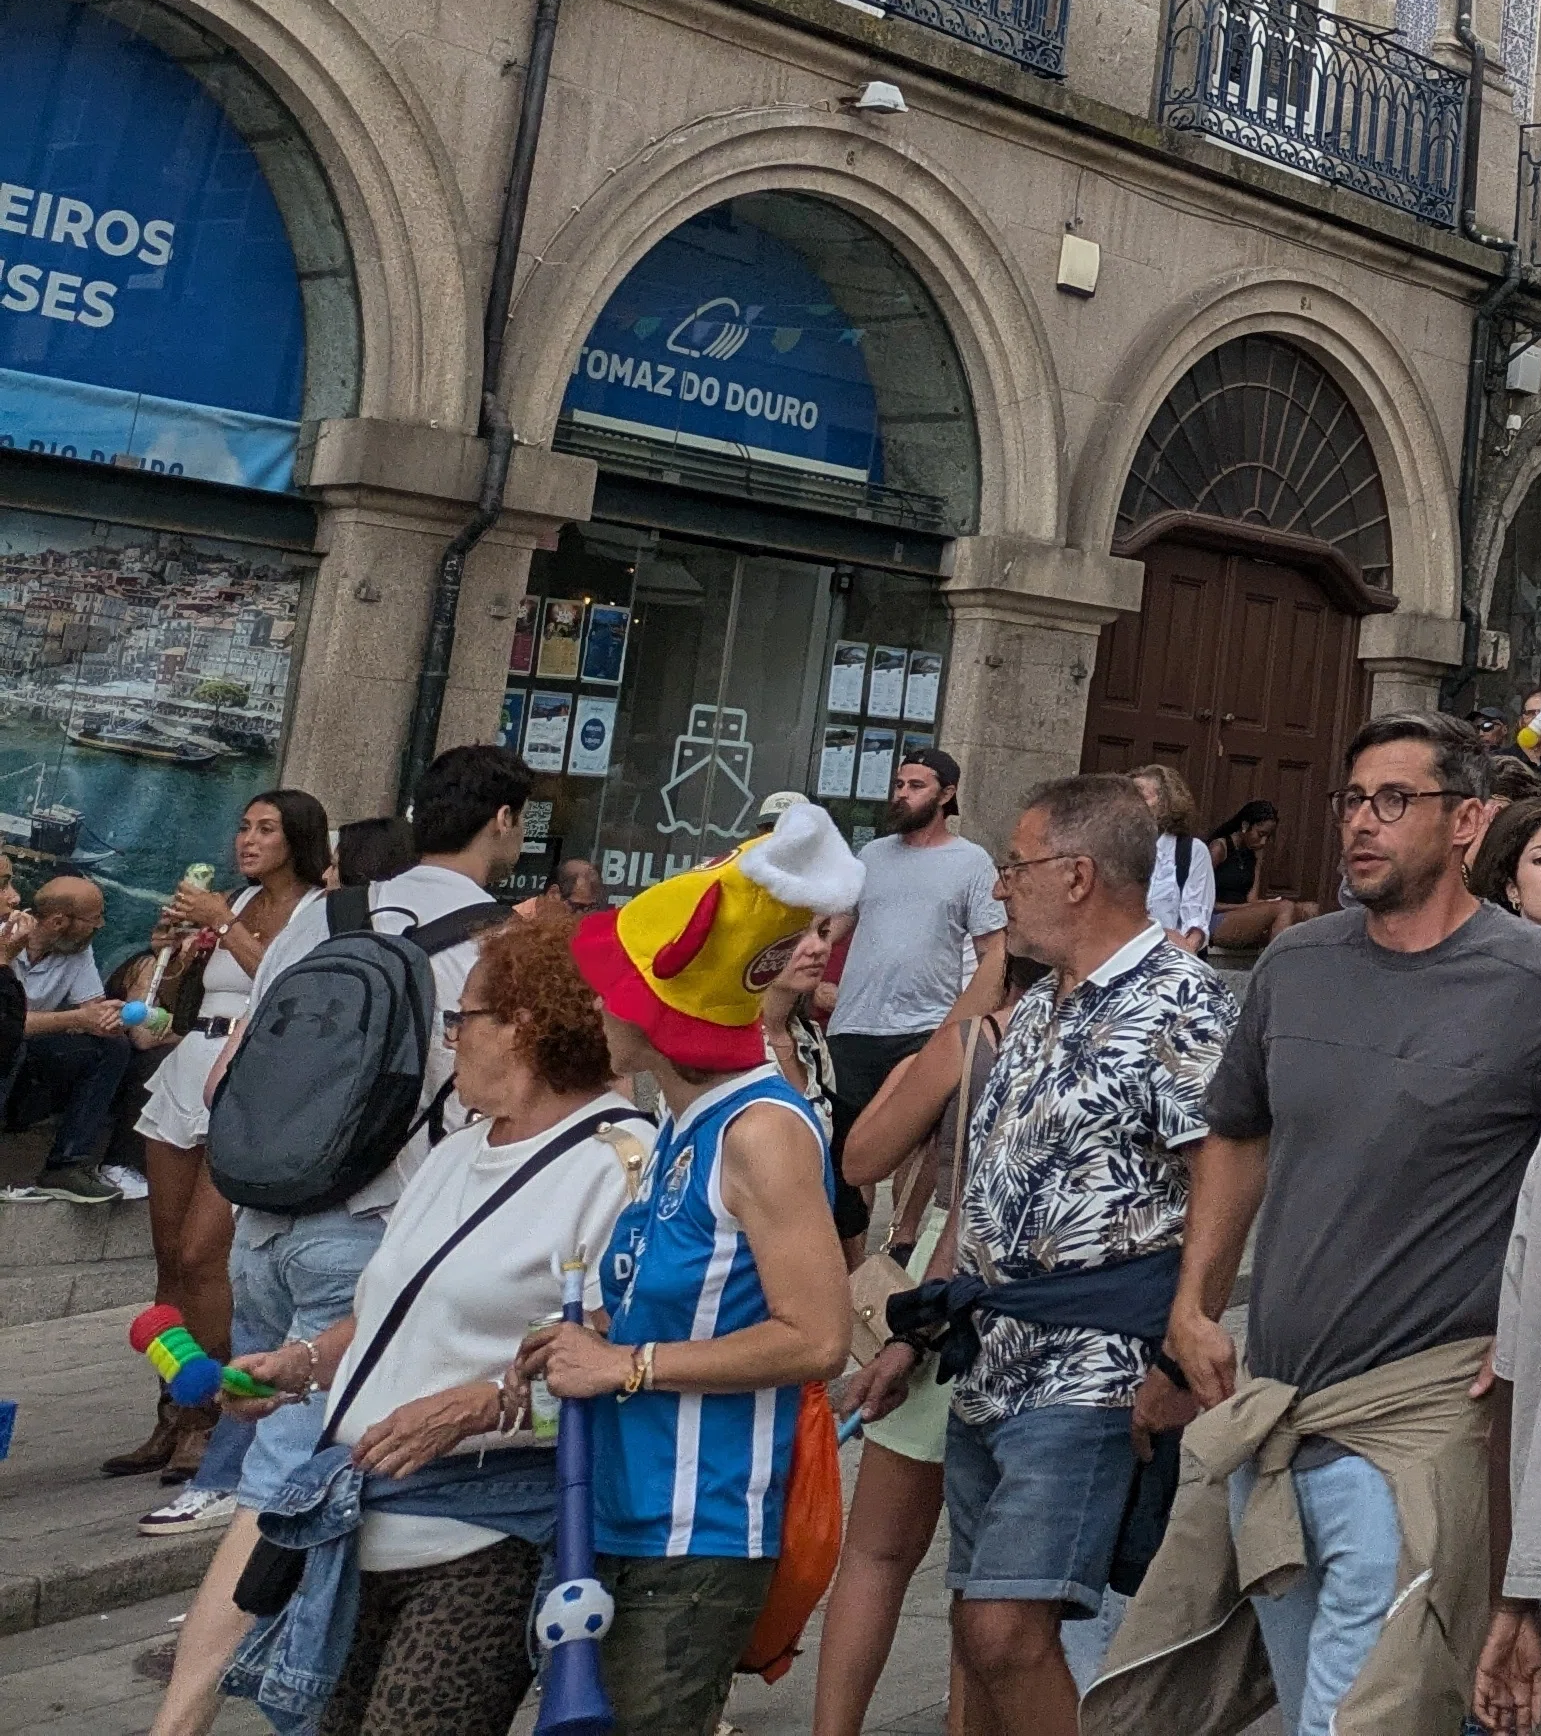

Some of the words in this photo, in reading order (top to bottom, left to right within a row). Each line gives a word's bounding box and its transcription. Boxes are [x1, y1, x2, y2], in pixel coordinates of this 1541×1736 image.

[0, 259, 118, 328] SES
[571, 346, 676, 397] TOMAZ
[679, 370, 720, 407] DO
[724, 381, 819, 430] DOURO
